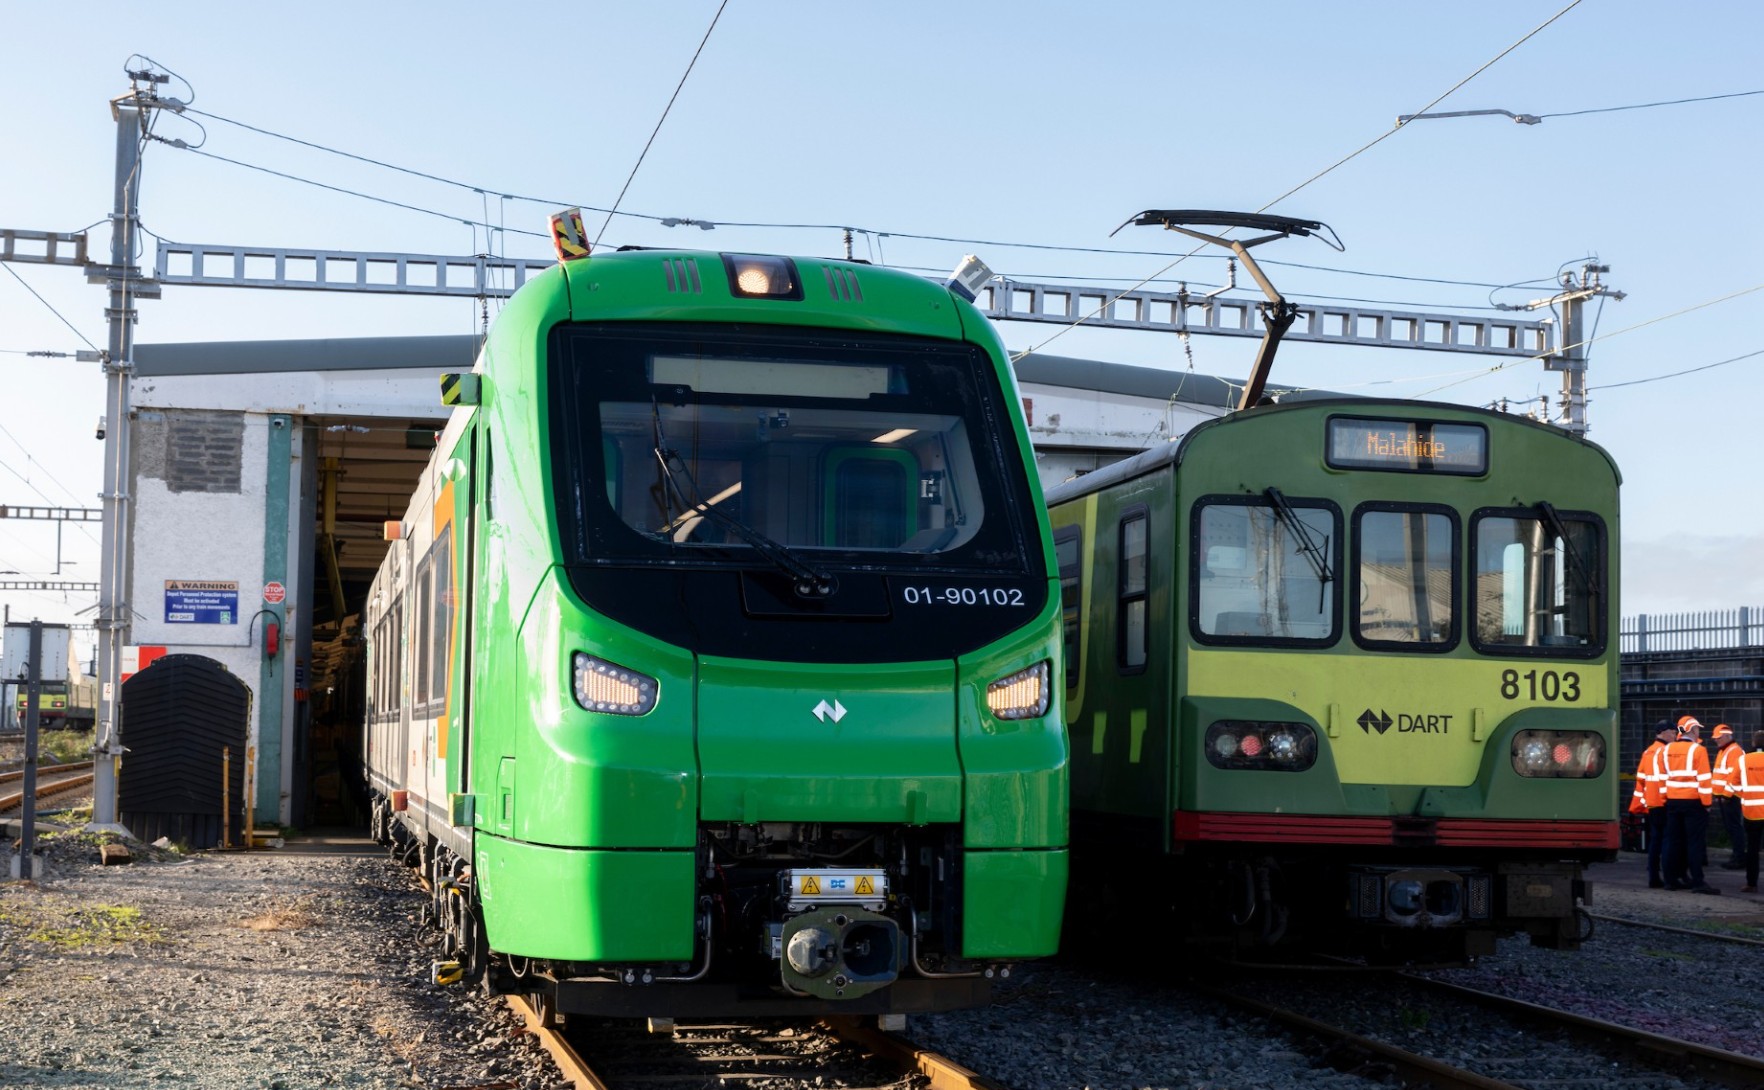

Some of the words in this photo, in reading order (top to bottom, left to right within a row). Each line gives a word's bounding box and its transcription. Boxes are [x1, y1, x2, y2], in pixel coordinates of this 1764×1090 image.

[1367, 431, 1445, 458] Malahide
[904, 587, 1025, 606] 01-90102
[1500, 668, 1581, 702] 8103
[1398, 714, 1453, 734] DART
